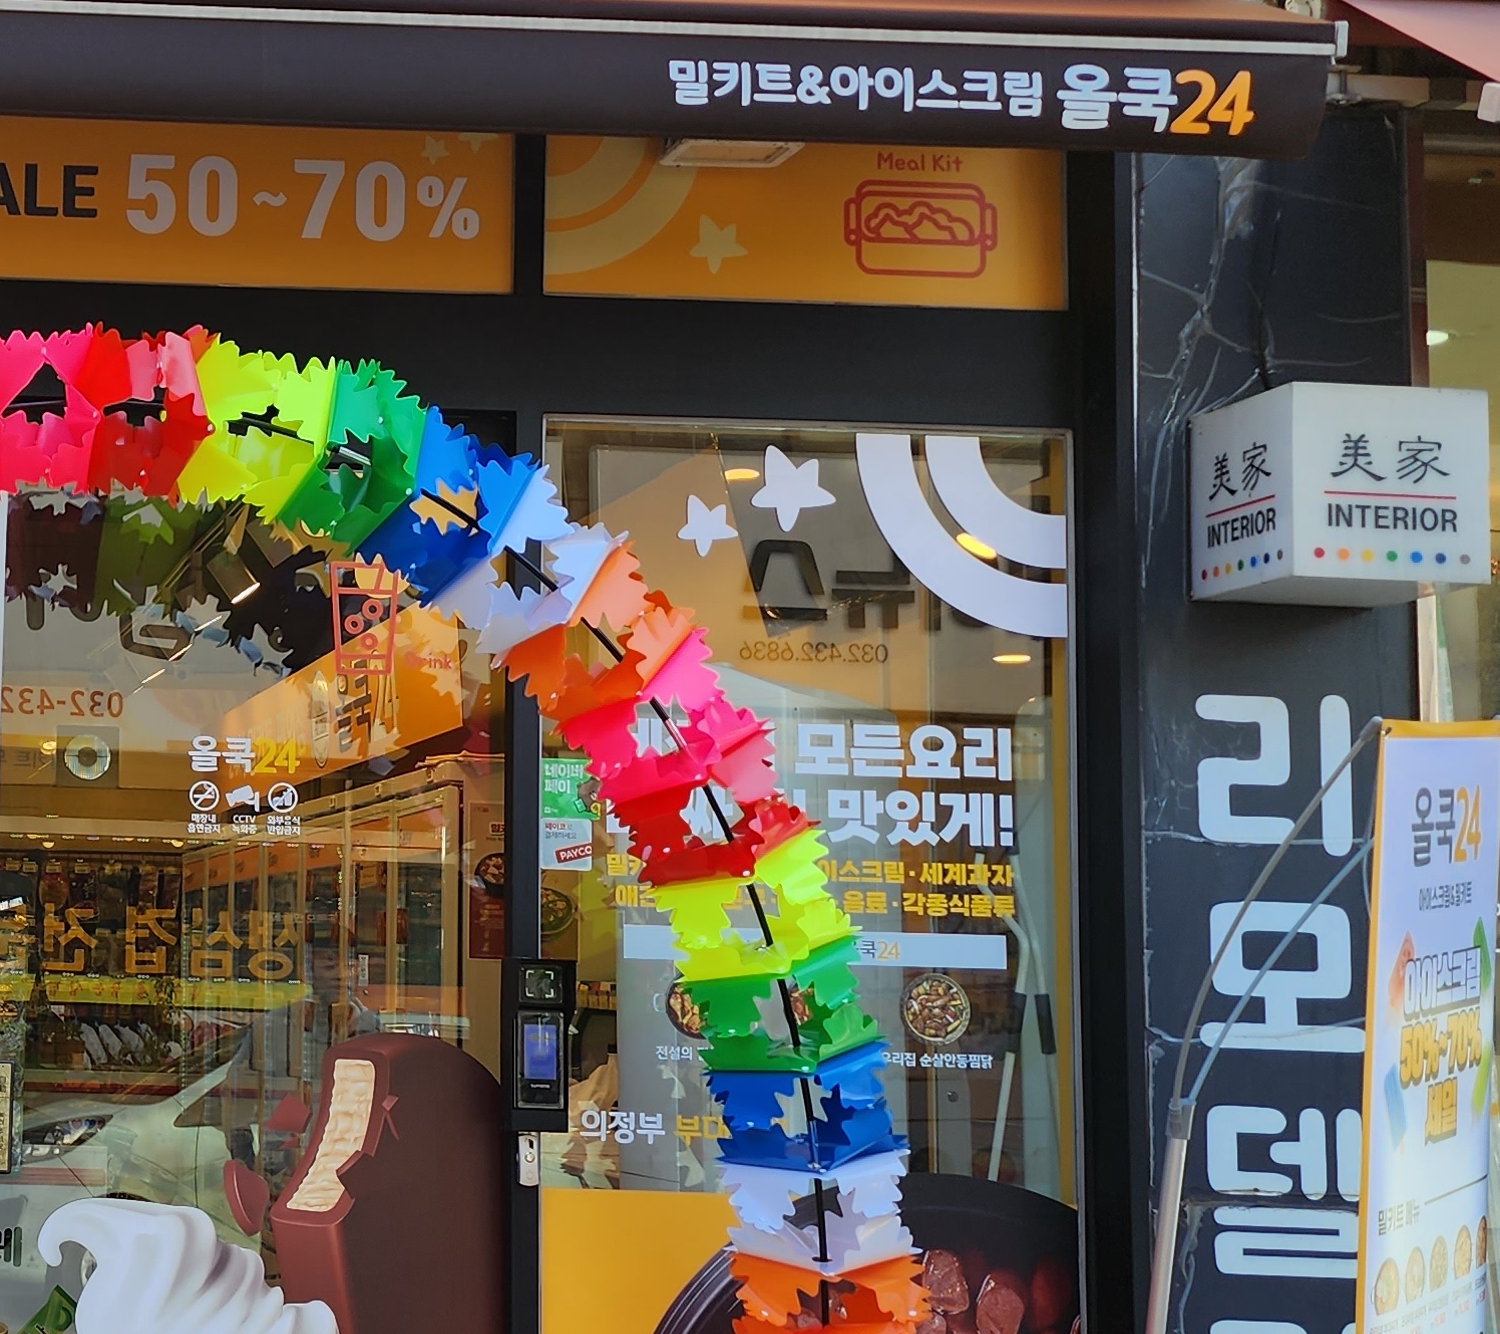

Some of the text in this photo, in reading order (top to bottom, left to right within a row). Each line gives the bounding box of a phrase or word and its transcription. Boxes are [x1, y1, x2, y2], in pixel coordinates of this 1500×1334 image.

[667, 58, 1256, 136] 밀키트&아이스크림 올쿡24
[877, 151, 964, 174] Meal Kit
[125, 153, 482, 242] 50~70%
[1208, 440, 1273, 502] 美家
[1329, 433, 1451, 485] 美家
[1206, 506, 1277, 549] INTERIOR
[1326, 501, 1458, 534] INTERIOR
[187, 735, 301, 774] 올쿡24
[795, 723, 1012, 781] 모든요리
[545, 779, 570, 793] 페이
[190, 814, 217, 823] 매장내
[231, 824, 258, 835] 녹화중
[232, 814, 257, 823] CCTV
[267, 815, 301, 826] 외부음식
[267, 825, 301, 836] 반입금지
[827, 788, 1014, 848] 맛있게!
[1412, 784, 1482, 867] 올쿡24
[560, 846, 592, 860] PAYCO
[1402, 946, 1482, 1018] 아이스크림
[655, 1045, 693, 1062] 전설의
[919, 1052, 993, 1071] 순살안동찜닭
[1400, 1007, 1482, 1089] 50%~70%
[580, 1109, 666, 1145] 의정부
[1424, 1076, 1457, 1146] 세일
